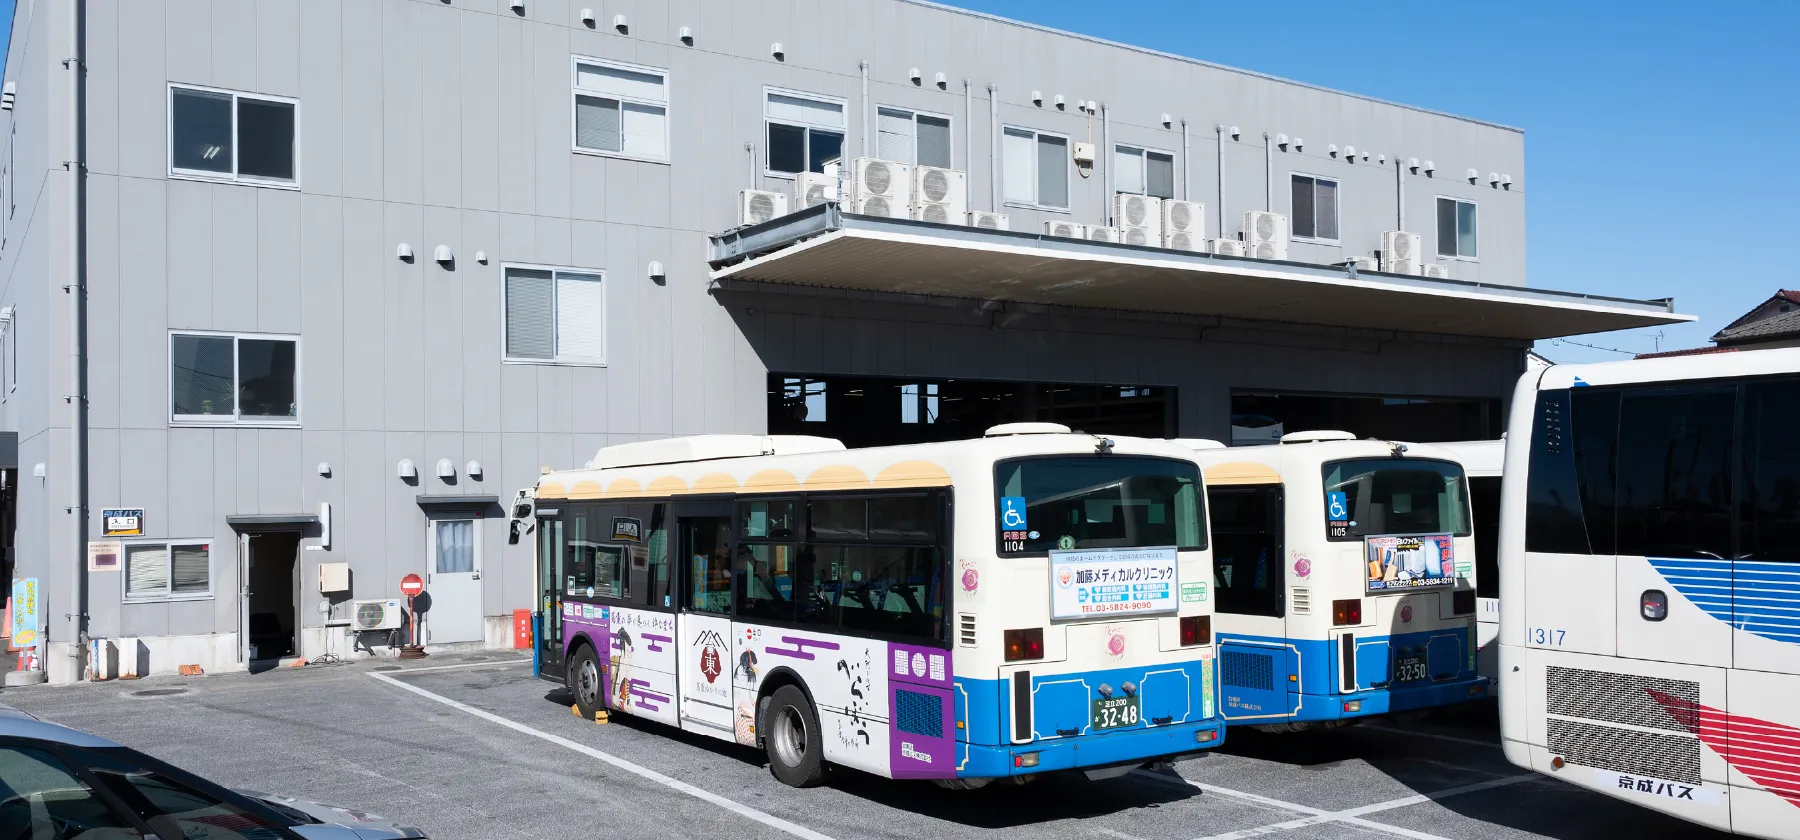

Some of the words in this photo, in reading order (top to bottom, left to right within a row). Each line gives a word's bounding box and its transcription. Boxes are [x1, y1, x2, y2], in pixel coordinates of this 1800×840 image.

[1004, 531, 1027, 540] ABS
[1331, 528, 1346, 536] 1105
[1004, 541, 1024, 551] 1104
[1076, 566, 1173, 584] 加藤メディカルクリニック
[1417, 578, 1453, 586] 03-5834-1211
[1529, 627, 1566, 646] 1317
[837, 659, 869, 745] べらぼう
[1618, 775, 1694, 800] 京成バス
